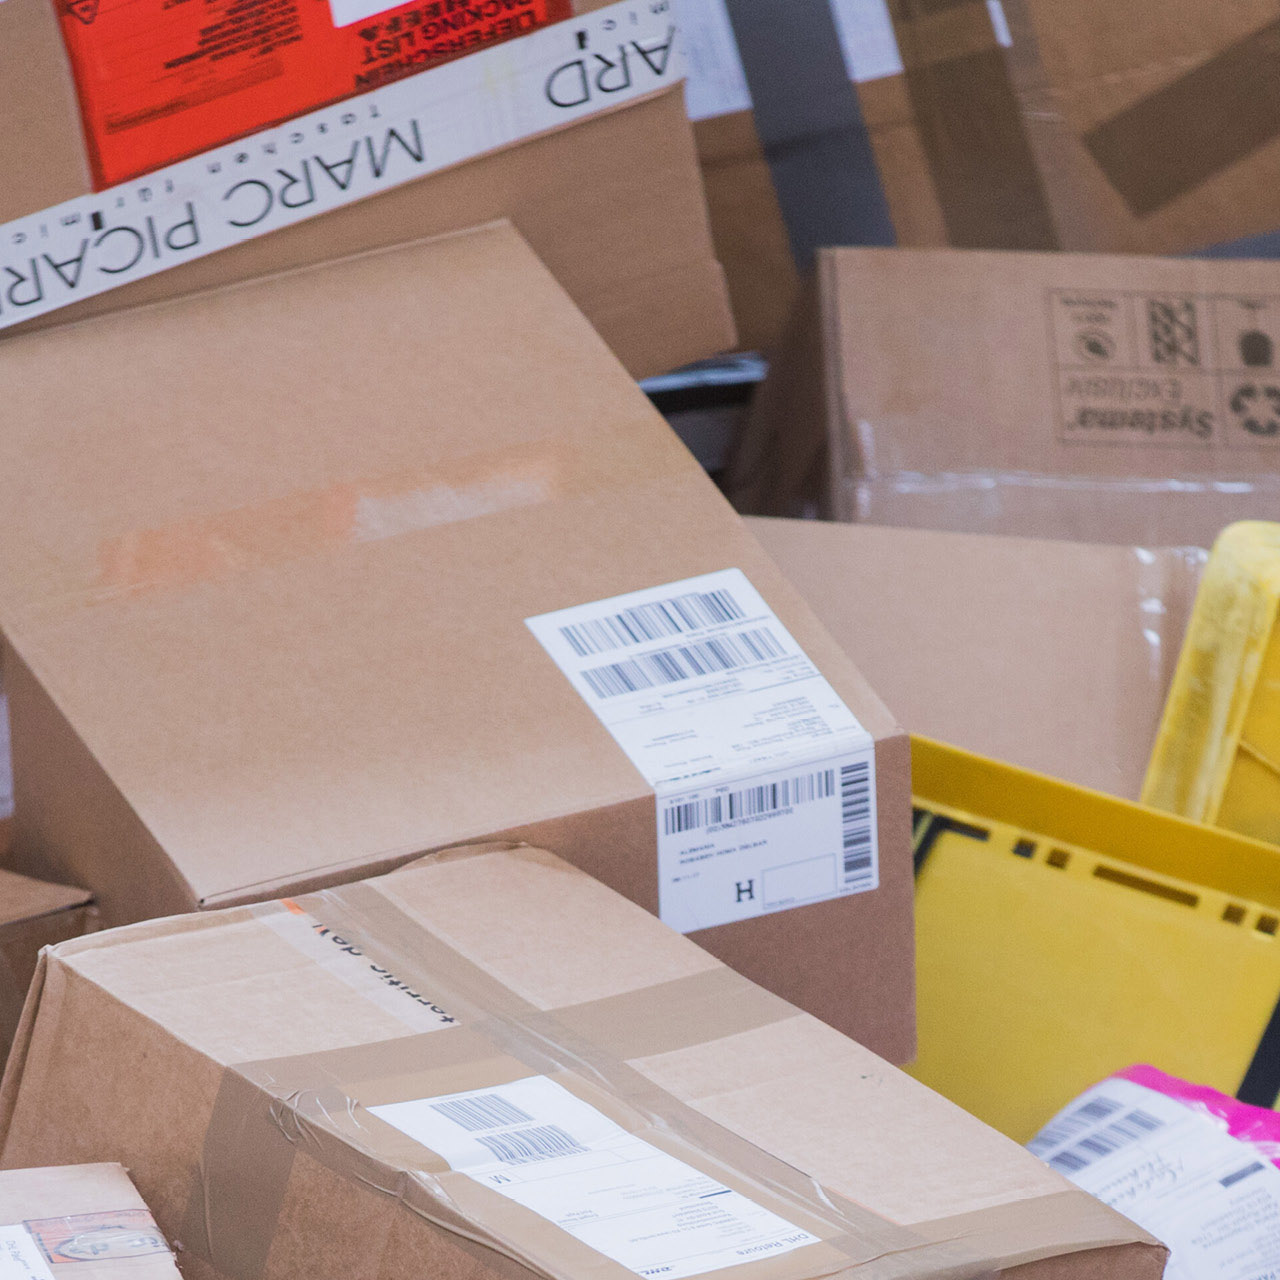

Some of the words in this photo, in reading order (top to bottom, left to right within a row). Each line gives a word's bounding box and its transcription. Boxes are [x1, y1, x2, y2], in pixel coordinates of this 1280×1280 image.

[358, 30, 416, 65] LIST
[210, 119, 438, 228] MARC
[1075, 402, 1213, 440] Systema
[735, 879, 755, 903] H
[733, 1237, 782, 1259] Retoure
[780, 1229, 810, 1247] DHL
